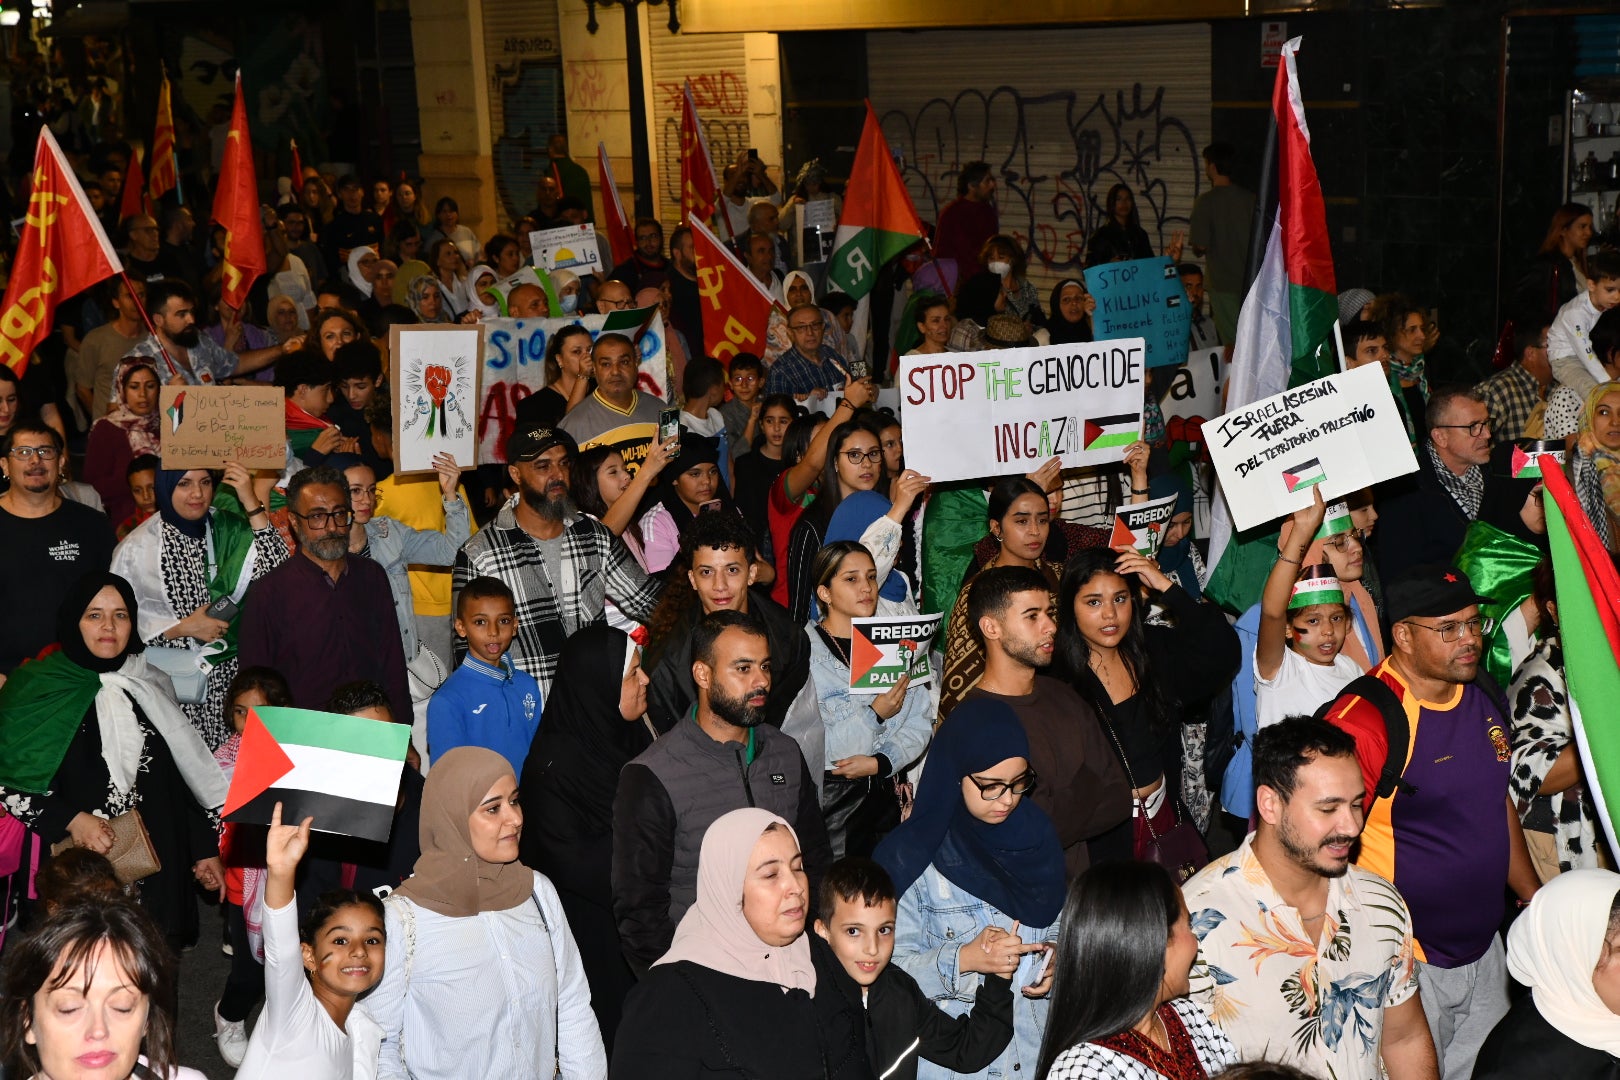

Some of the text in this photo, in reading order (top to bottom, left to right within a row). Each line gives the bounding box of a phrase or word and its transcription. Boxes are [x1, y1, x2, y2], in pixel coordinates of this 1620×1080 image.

[1099, 265, 1139, 290] STOP
[1103, 292, 1160, 314] KILLING
[1103, 317, 1153, 334] Innocent
[907, 348, 1142, 406] STOP THE GENOCIDE
[190, 391, 219, 419] You
[1216, 380, 1338, 448] ISRAEL ASESINA
[1023, 416, 1079, 459] GAZA
[1250, 411, 1304, 441] FUERA
[1234, 454, 1264, 478] DEL
[48, 543, 80, 552] WORKING
